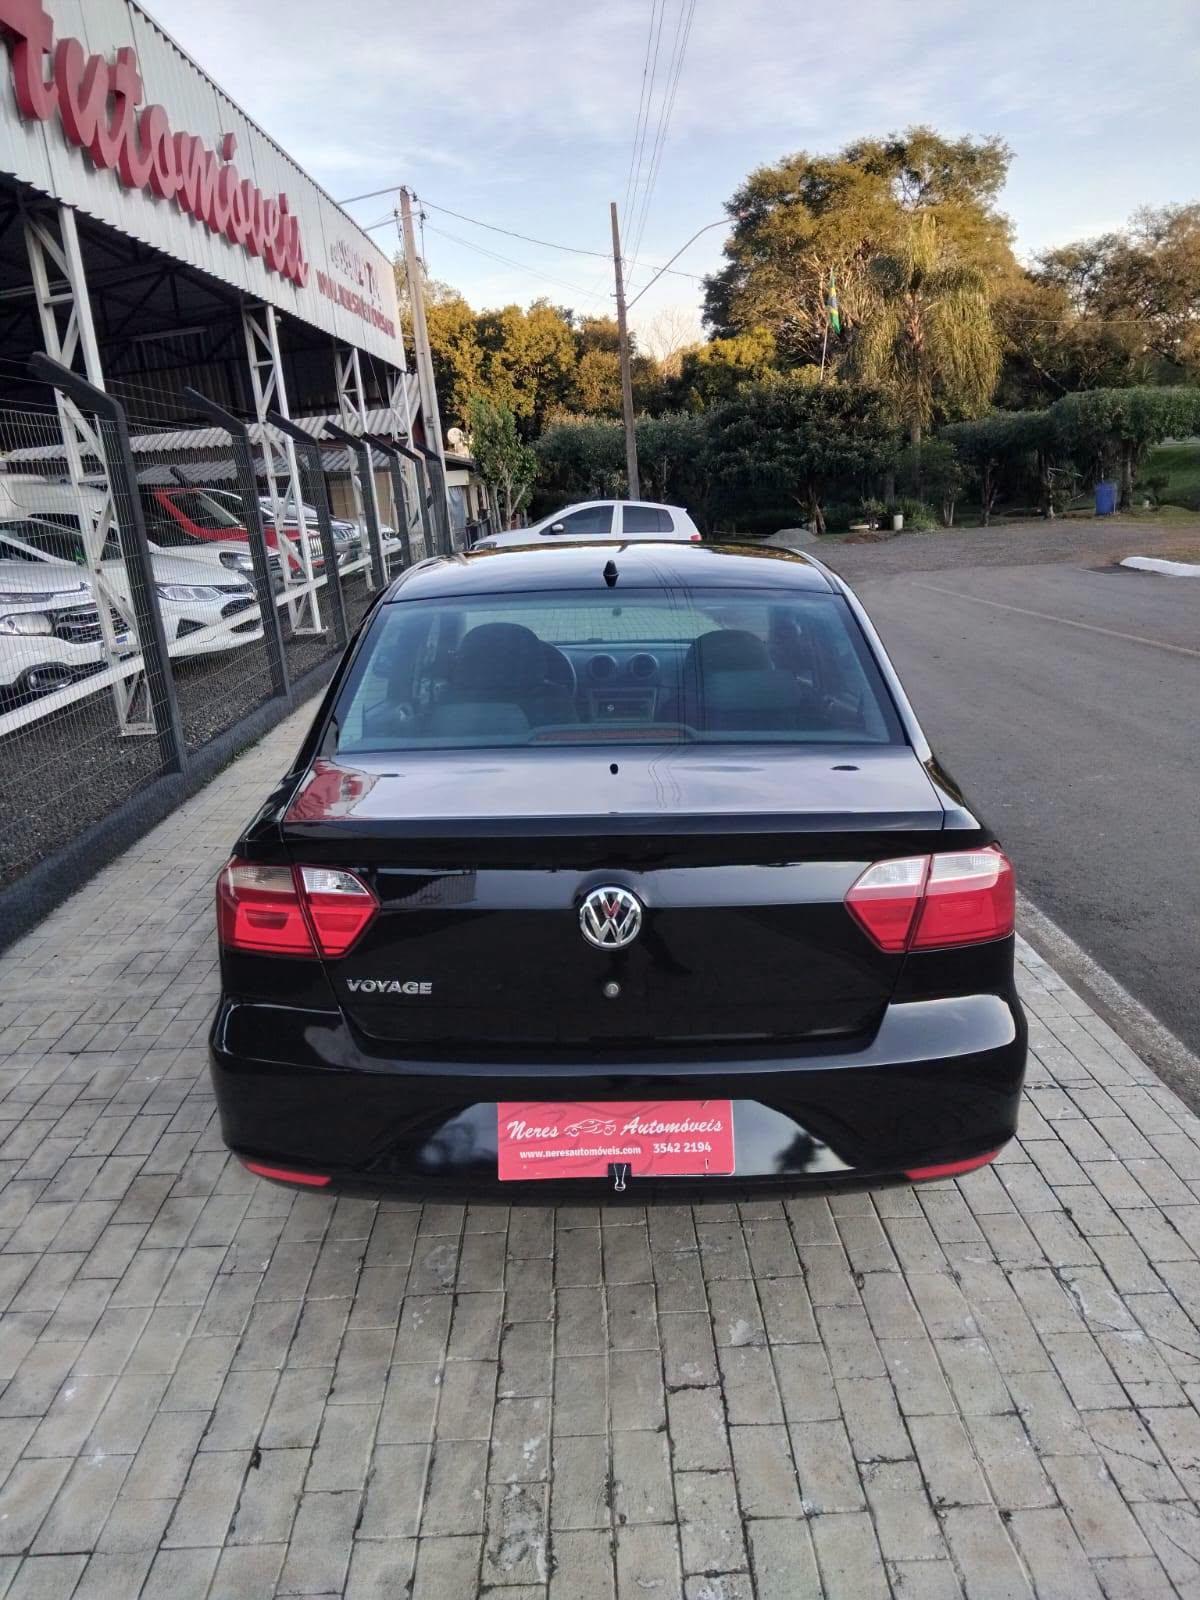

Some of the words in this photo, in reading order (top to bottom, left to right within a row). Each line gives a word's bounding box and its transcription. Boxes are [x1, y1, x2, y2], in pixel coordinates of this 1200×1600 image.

[347, 978, 433, 995] VOYAGE
[507, 1120, 559, 1139] Neres
[621, 1116, 723, 1136] Automóveis
[519, 1145, 641, 1159] www.neresautomóveis.com
[653, 1142, 681, 1153] 3542
[684, 1142, 712, 1153] 2194
